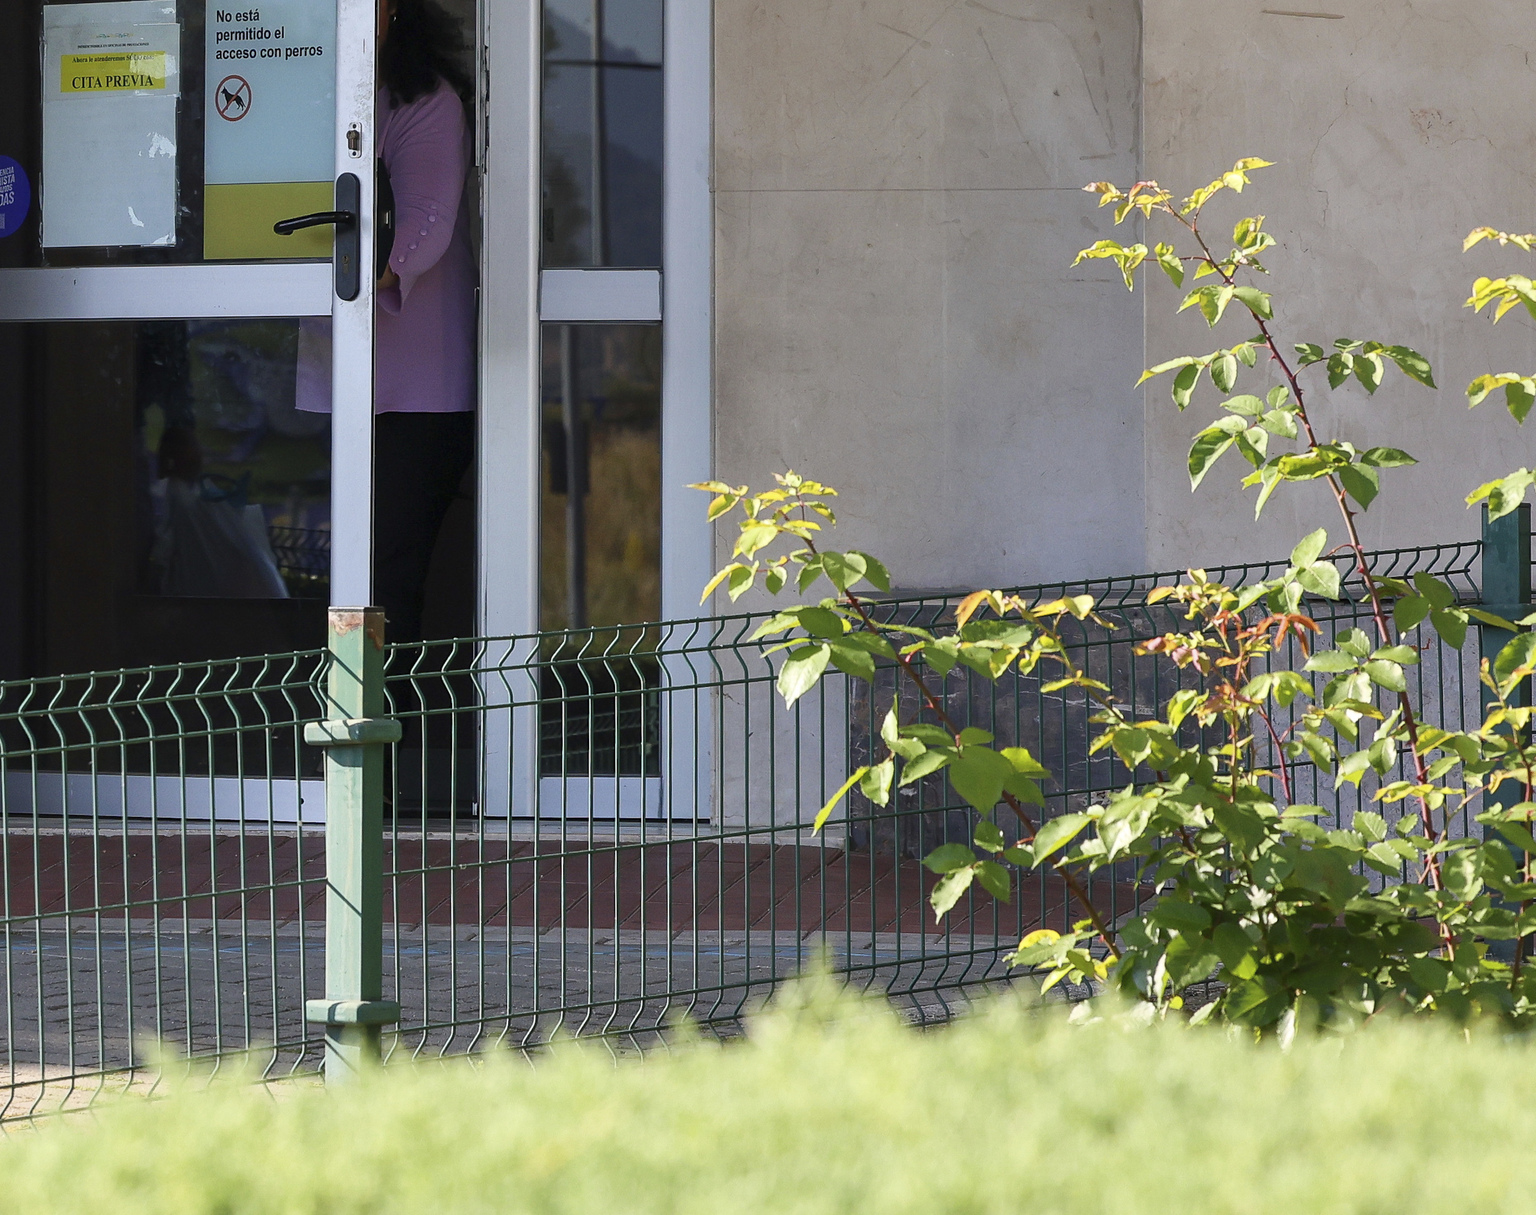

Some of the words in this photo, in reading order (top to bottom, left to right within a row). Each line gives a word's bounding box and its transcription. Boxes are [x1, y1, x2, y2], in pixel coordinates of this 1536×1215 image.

[216, 10, 234, 24] No
[236, 8, 260, 22] está
[216, 27, 271, 45] permitido
[274, 25, 285, 40] el
[216, 47, 257, 60] acceso
[260, 47, 283, 59] con
[285, 45, 324, 61] perros
[71, 76, 102, 89] CITA
[105, 74, 154, 88] PREVIA
